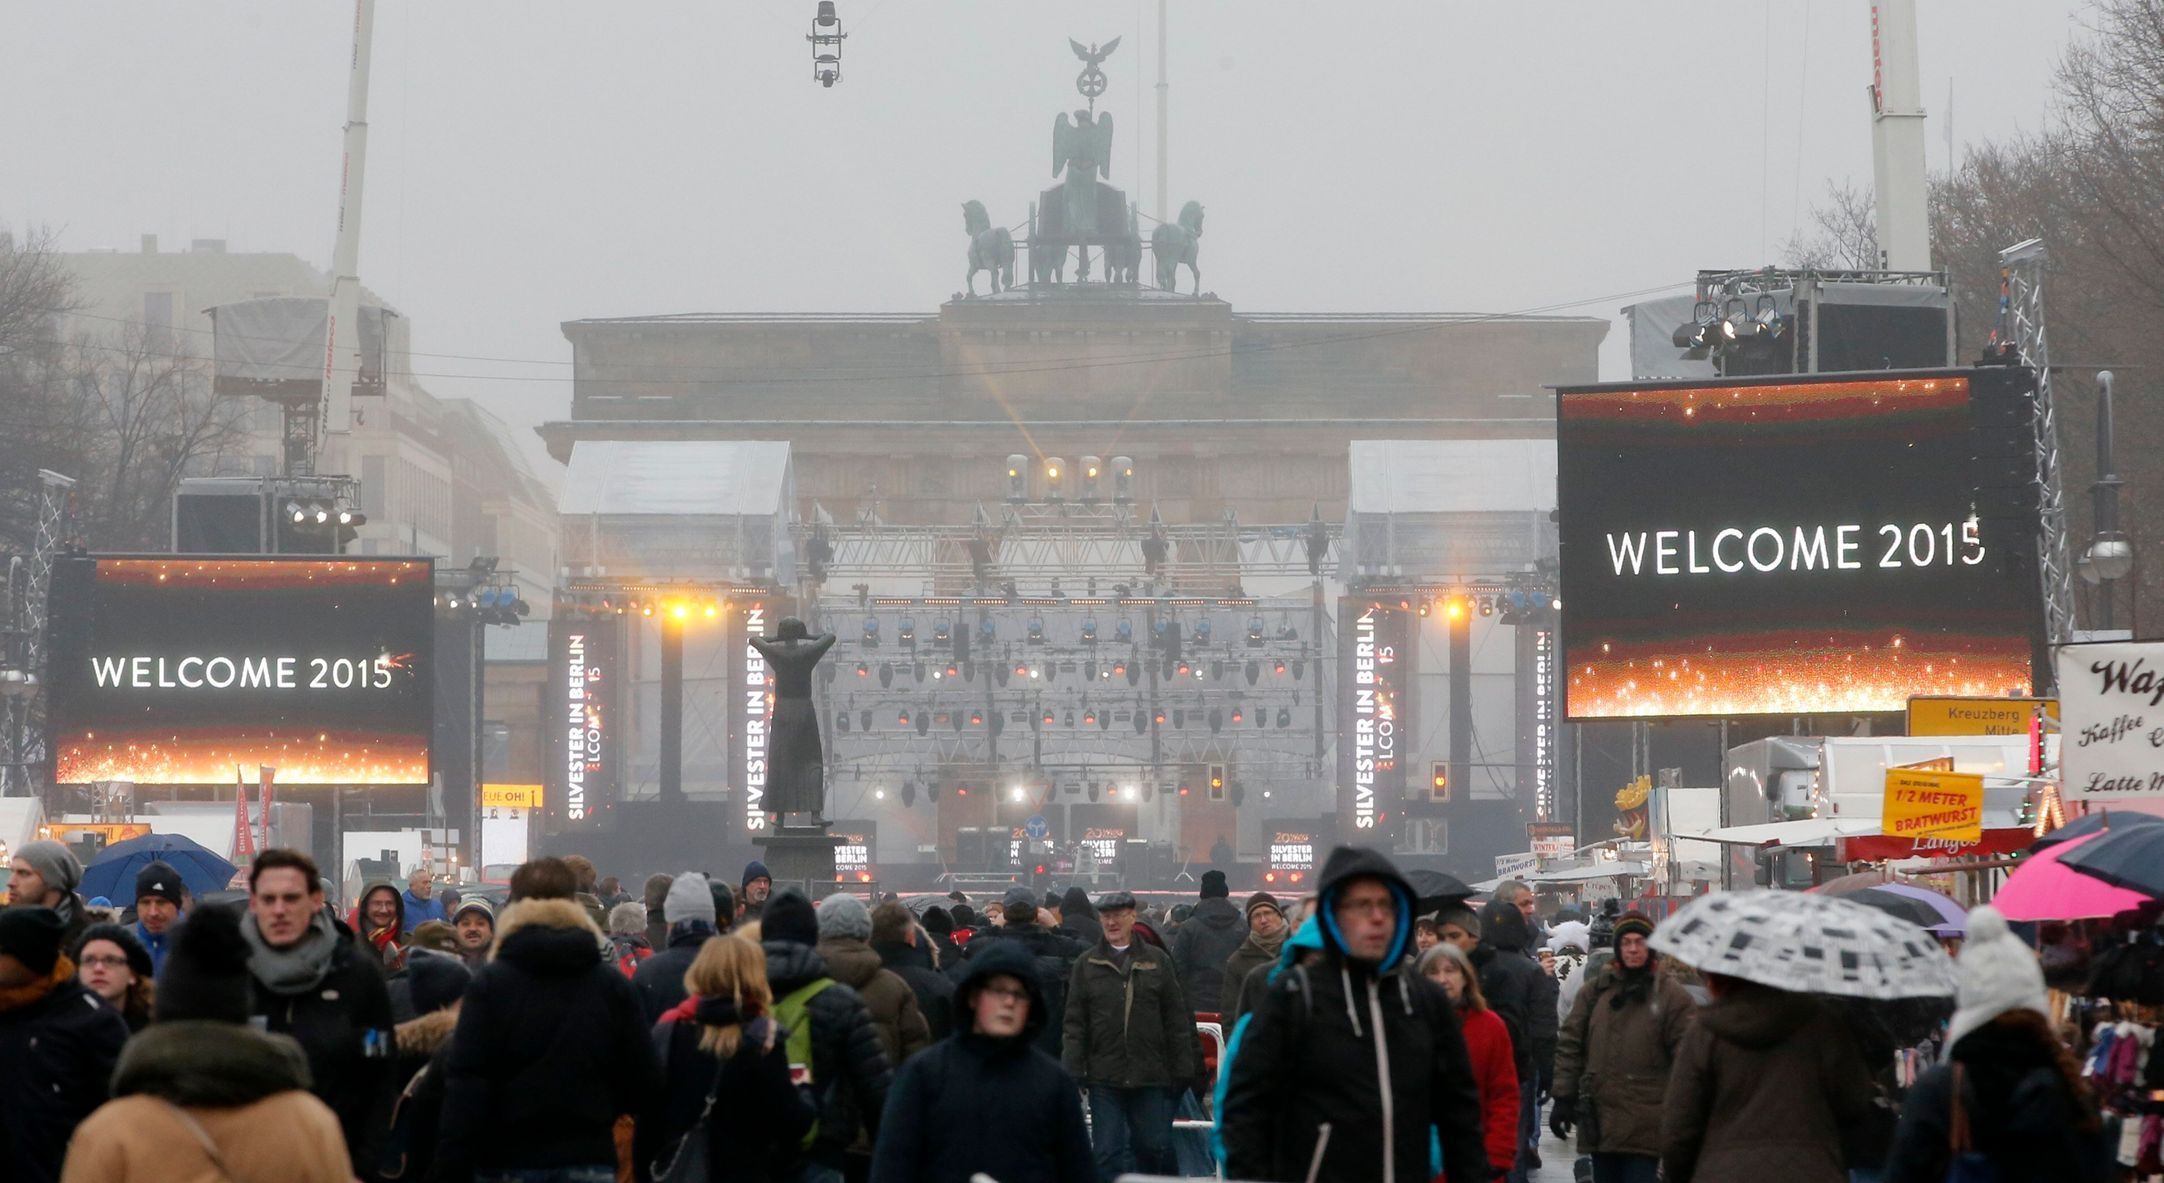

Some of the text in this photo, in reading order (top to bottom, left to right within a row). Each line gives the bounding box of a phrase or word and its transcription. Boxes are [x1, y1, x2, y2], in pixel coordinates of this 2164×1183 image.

[1606, 521, 1985, 576] WELCOME 2015
[747, 609, 764, 685] BERIN
[92, 656, 392, 689] WELCOME 2015
[747, 691, 764, 714] IN
[1356, 608, 1374, 828] SILVESTER IN BERLIN
[1949, 708, 2020, 722] Kreuzberg
[569, 635, 584, 820] SILVESTER IN BERLIN
[1985, 725, 2019, 736] Mitte
[2078, 714, 2144, 747] Kaffee
[2083, 772, 2144, 793] Latte
[483, 791, 525, 801] EUE OH!
[1896, 790, 1968, 807] 1/2 METER
[1895, 807, 1977, 832] BRATWURST
[834, 845, 867, 855] VESTER
[835, 855, 868, 863] BERLIN
[1270, 844, 1313, 854] SILVESTER
[1270, 854, 1313, 863] IN BERLIN
